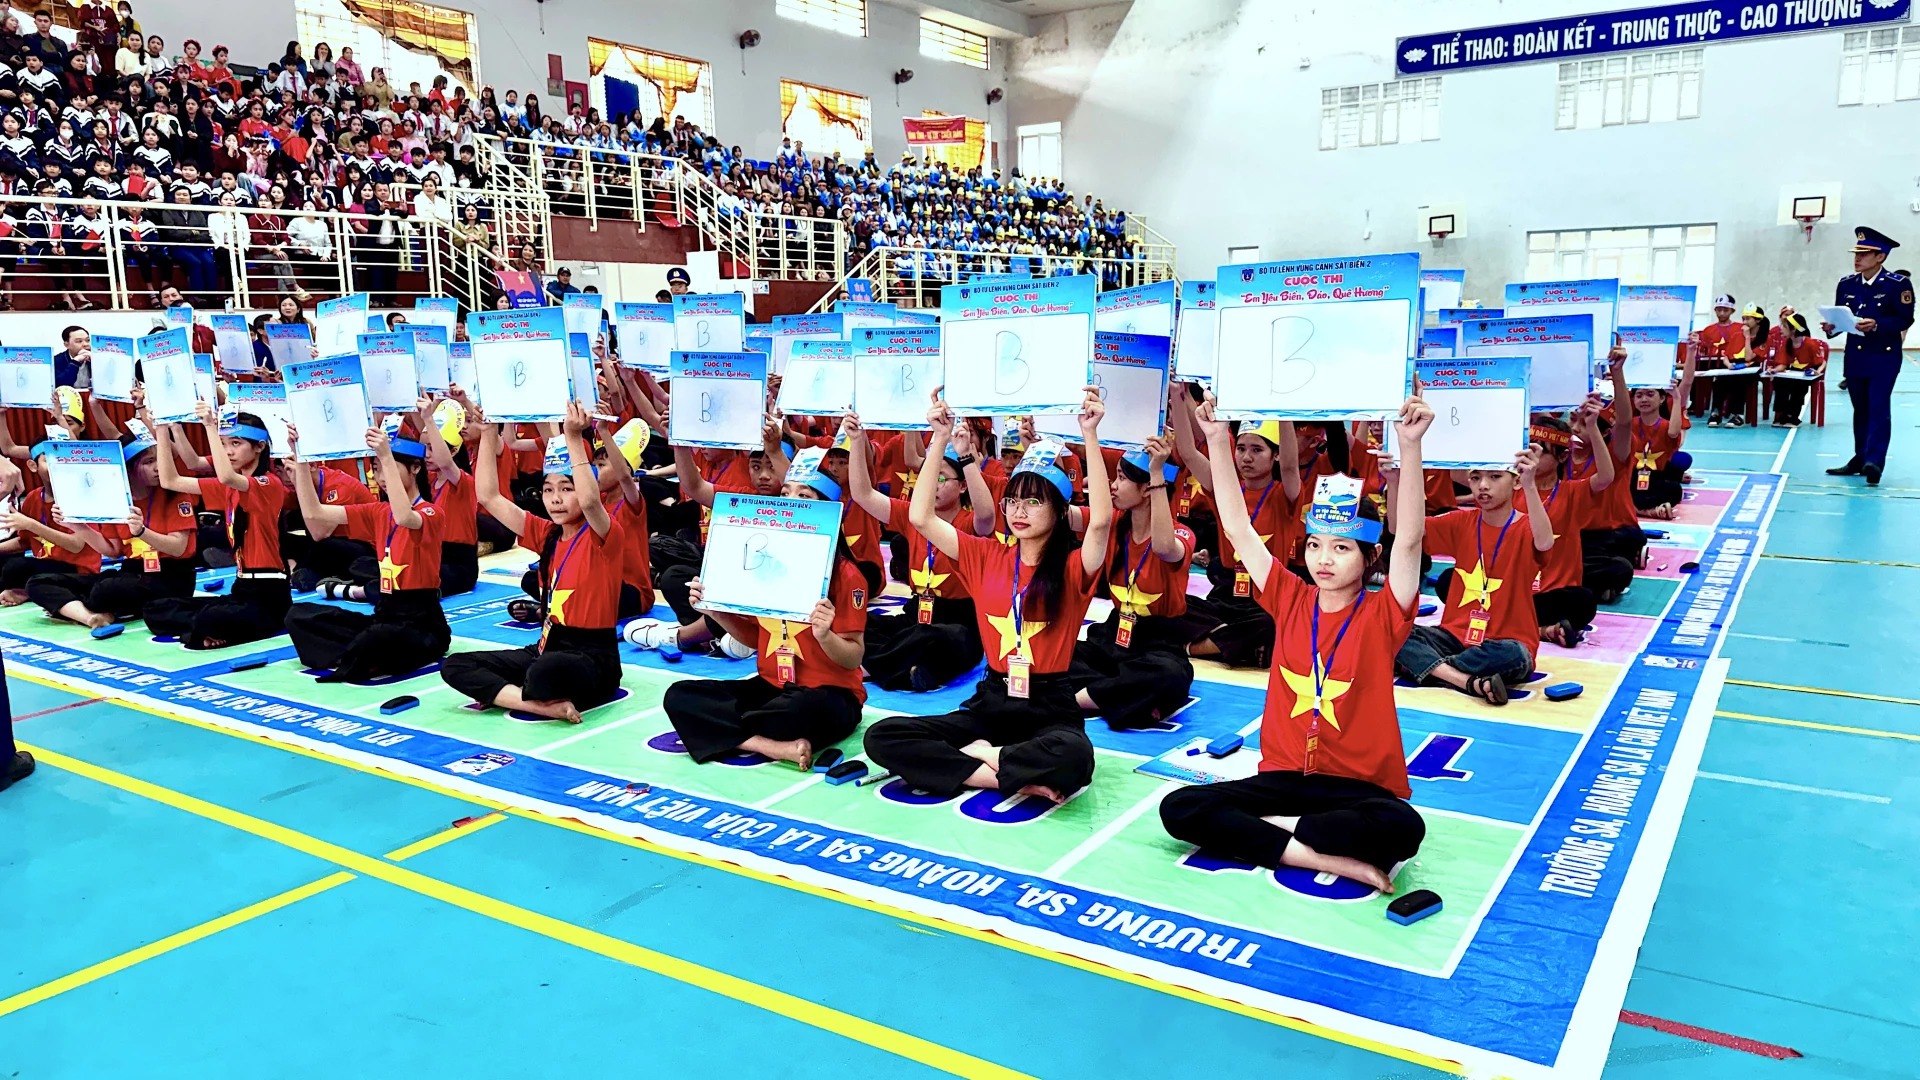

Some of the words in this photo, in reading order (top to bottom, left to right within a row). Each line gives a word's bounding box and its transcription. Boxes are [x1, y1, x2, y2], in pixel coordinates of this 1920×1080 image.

[1431, 38, 1461, 65] THỂ
[1464, 38, 1508, 62] THAO:
[1513, 29, 1558, 57] ĐOÀN
[1562, 23, 1594, 52] KẾT
[1611, 21, 1669, 46] TRUNG
[1675, 9, 1721, 41] THỰC
[1741, 4, 1777, 30] CAO
[1284, 274, 1318, 287] CUỘC
[1323, 274, 1343, 284] THI
[994, 293, 1019, 303] CUỘC
[501, 321, 518, 329] CUỘC
[697, 320, 710, 348] B
[995, 330, 1030, 395] B
[1269, 316, 1316, 395] B
[514, 361, 526, 389] B
[902, 363, 915, 396] B
[1435, 369, 1459, 377] CUỘC
[323, 399, 334, 422] B
[701, 392, 711, 423] B
[1451, 406, 1460, 427] B
[757, 508, 777, 516] CUỘC
[1238, 583, 1246, 592] 22
[1015, 677, 1023, 691] 02
[564, 779, 642, 808] NAM
[702, 806, 778, 839] CỦA
[768, 827, 817, 852] LÀ
[817, 837, 876, 864] SA
[868, 848, 1006, 895] HOÀNG
[1017, 881, 1077, 918] SA,
[1078, 902, 1262, 969] TRƯỜNG
